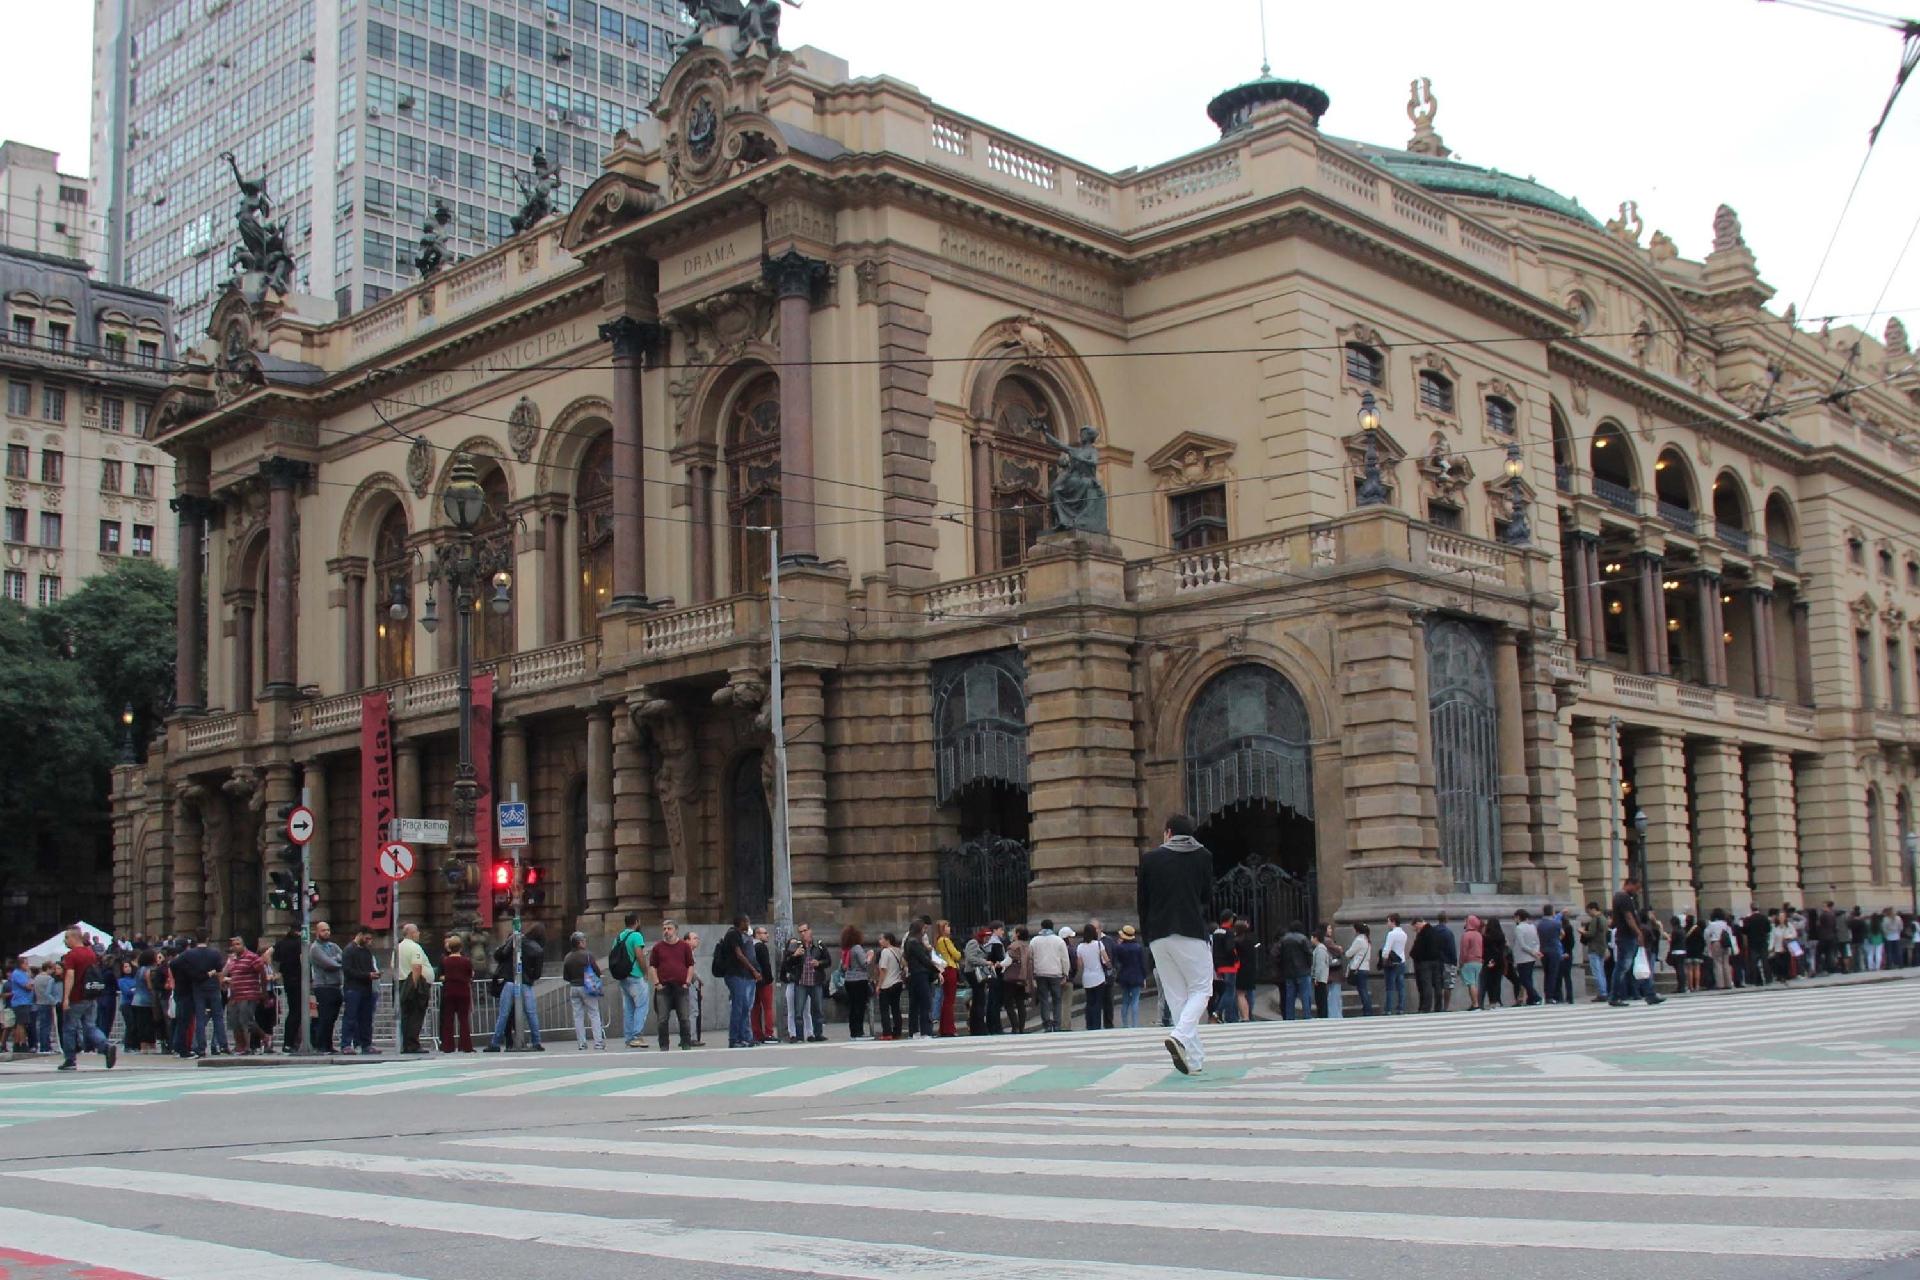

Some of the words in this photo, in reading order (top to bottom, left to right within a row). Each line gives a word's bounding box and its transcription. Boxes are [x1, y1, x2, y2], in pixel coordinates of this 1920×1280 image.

[683, 242, 736, 276] DRAMA
[402, 820, 422, 832] Praça
[424, 821, 449, 832] Ramos
[372, 886, 389, 920] la
